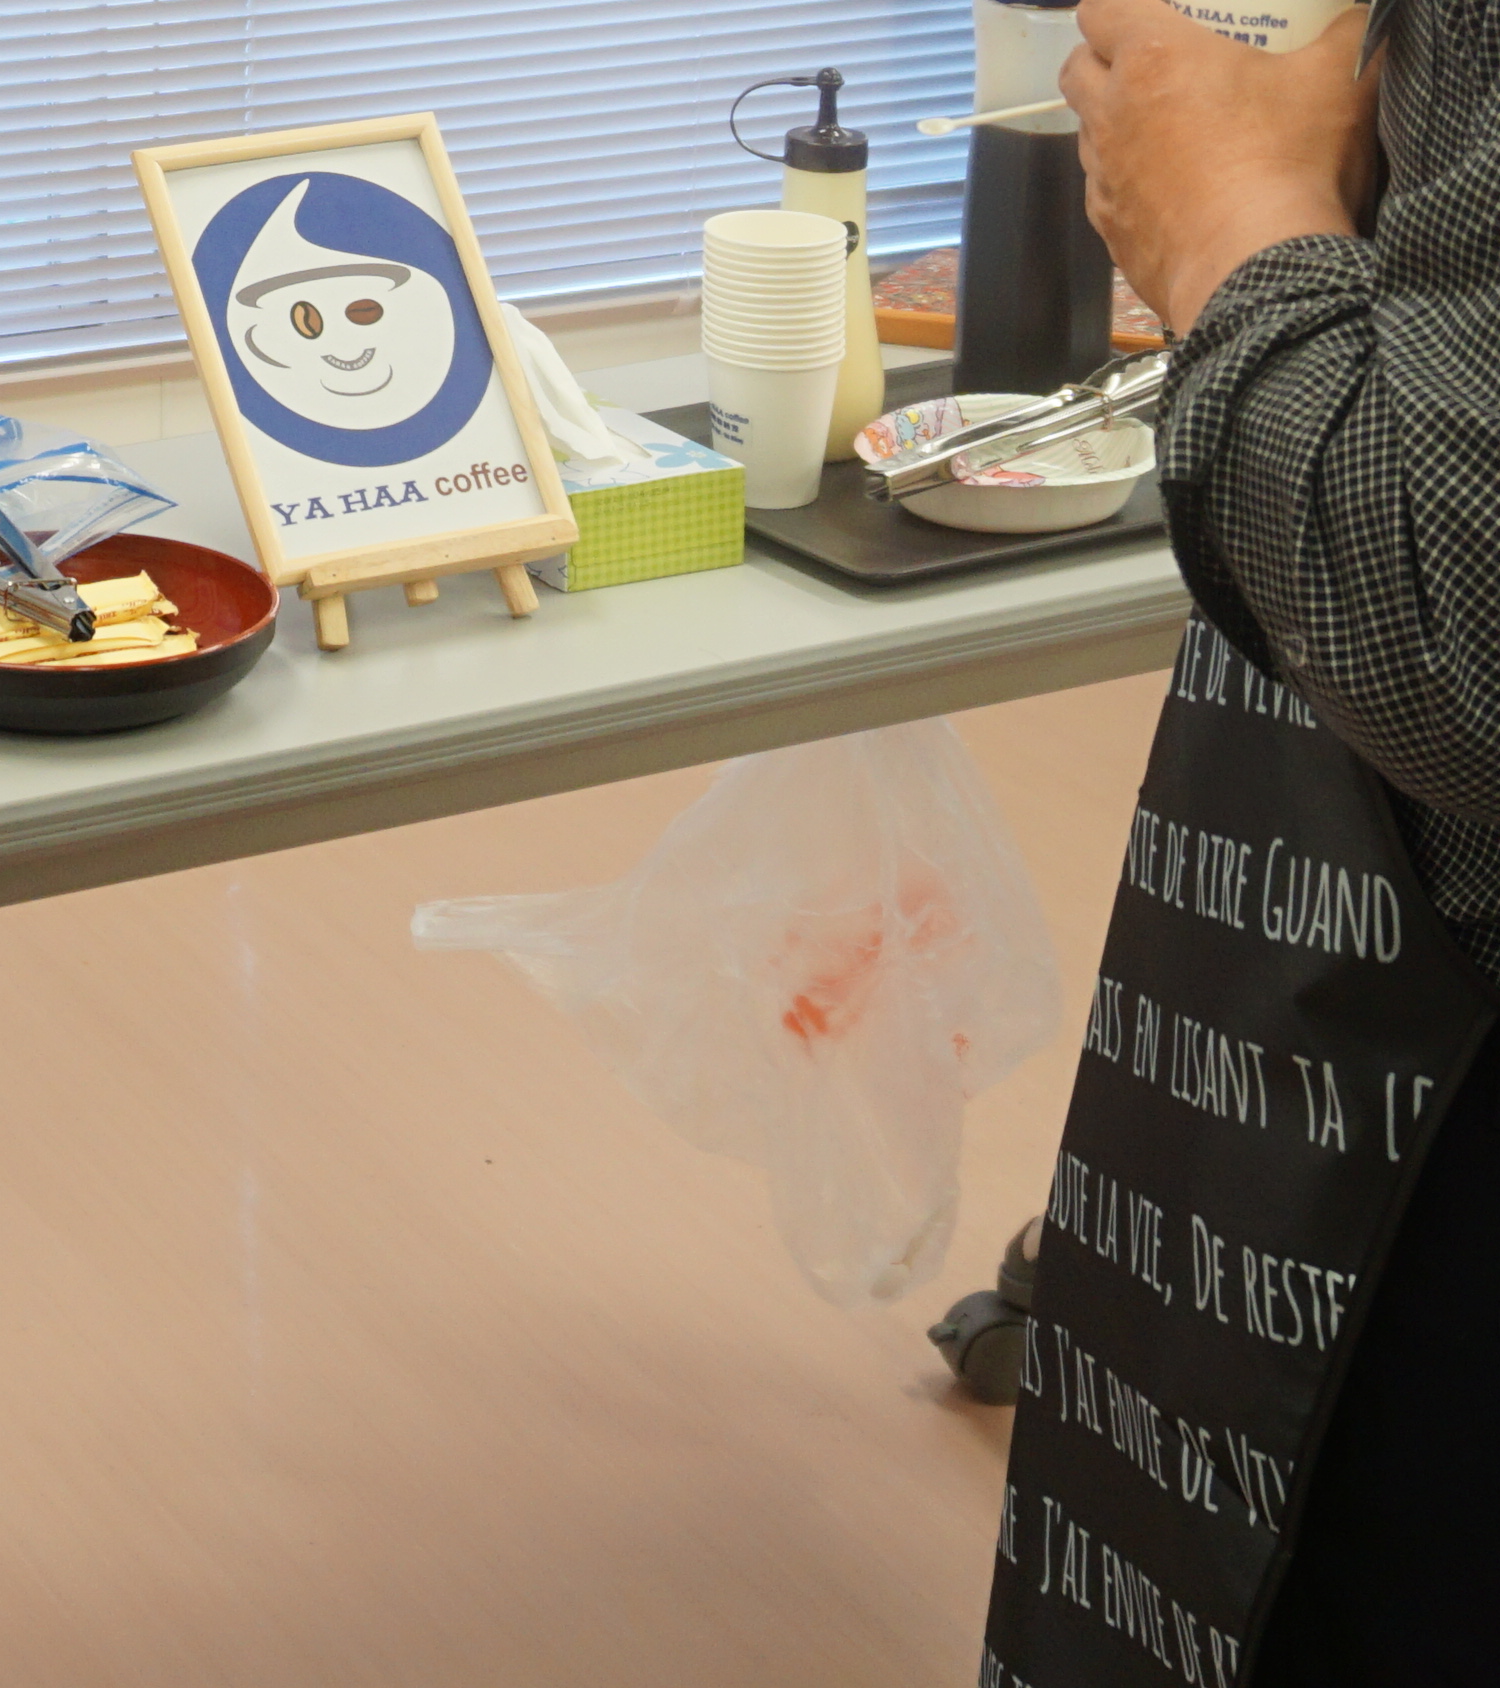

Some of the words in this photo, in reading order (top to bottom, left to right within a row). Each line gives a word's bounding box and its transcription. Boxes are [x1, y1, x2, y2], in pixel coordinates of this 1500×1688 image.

[1196, 8, 1236, 25] HAA
[1240, 14, 1288, 29] coffee
[271, 496, 335, 527] YA
[337, 480, 429, 515] HAA
[434, 462, 529, 497] coffee
[1163, 821, 1190, 909] DE
[1196, 829, 1252, 930] RIRE
[1083, 975, 1124, 1064] AIS
[1133, 993, 1162, 1084] EN
[1171, 1012, 1268, 1130] LISANT
[1292, 1054, 1346, 1153] TA
[1096, 1173, 1119, 1265] LA
[1129, 1190, 1173, 1307] VIE,
[1191, 1213, 1230, 1325] DE
[1242, 1244, 1357, 1353] RESTE
[1053, 1323, 1103, 1435] J'AI
[1105, 1367, 1169, 1490] ENVIE
[1176, 1415, 1219, 1514] DE
[1040, 1495, 1092, 1610] J'AI
[1102, 1542, 1173, 1670] ENVIE
